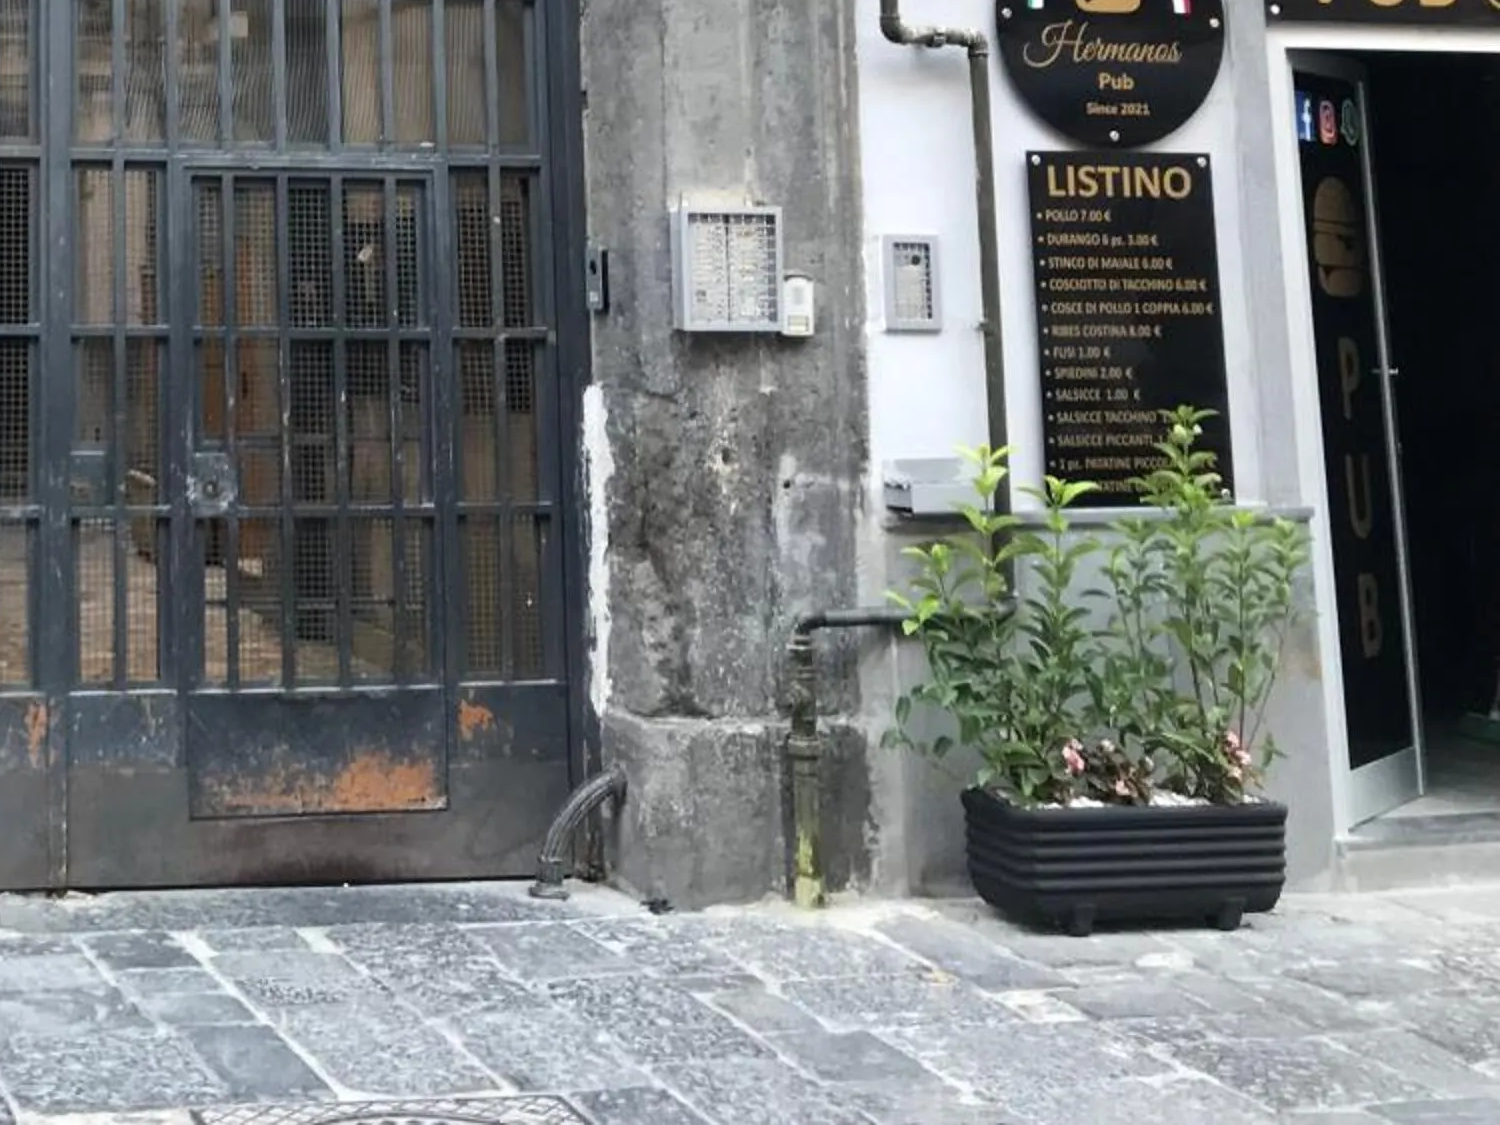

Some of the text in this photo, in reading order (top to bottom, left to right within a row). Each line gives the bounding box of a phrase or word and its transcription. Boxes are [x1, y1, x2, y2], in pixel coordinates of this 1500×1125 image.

[1023, 19, 1182, 68] Hermanos
[1097, 73, 1135, 90] Pub
[1086, 101, 1151, 116] Since 2021
[1047, 165, 1192, 200] LISTINO
[1045, 209, 1079, 222] POLLO
[1048, 257, 1085, 270] STINCO
[1087, 257, 1099, 270] DI
[1101, 257, 1140, 270] MAIALE
[1049, 278, 1107, 291] COSCIOTTO
[1109, 279, 1120, 291] DI
[1122, 279, 1173, 291] TACCHINO
[1051, 302, 1083, 314] COSCE
[1085, 302, 1097, 314] DI
[1099, 302, 1132, 314] POLLO
[1143, 302, 1181, 314] COPPIA
[1055, 389, 1101, 402] SALSICCE
[1057, 411, 1102, 424] SALSICCE
[1104, 411, 1157, 424] TACCHINO
[1058, 434, 1103, 447] SALSICCE
[1134, 457, 1174, 470] PICCOL
[1338, 337, 1383, 659] PUB
